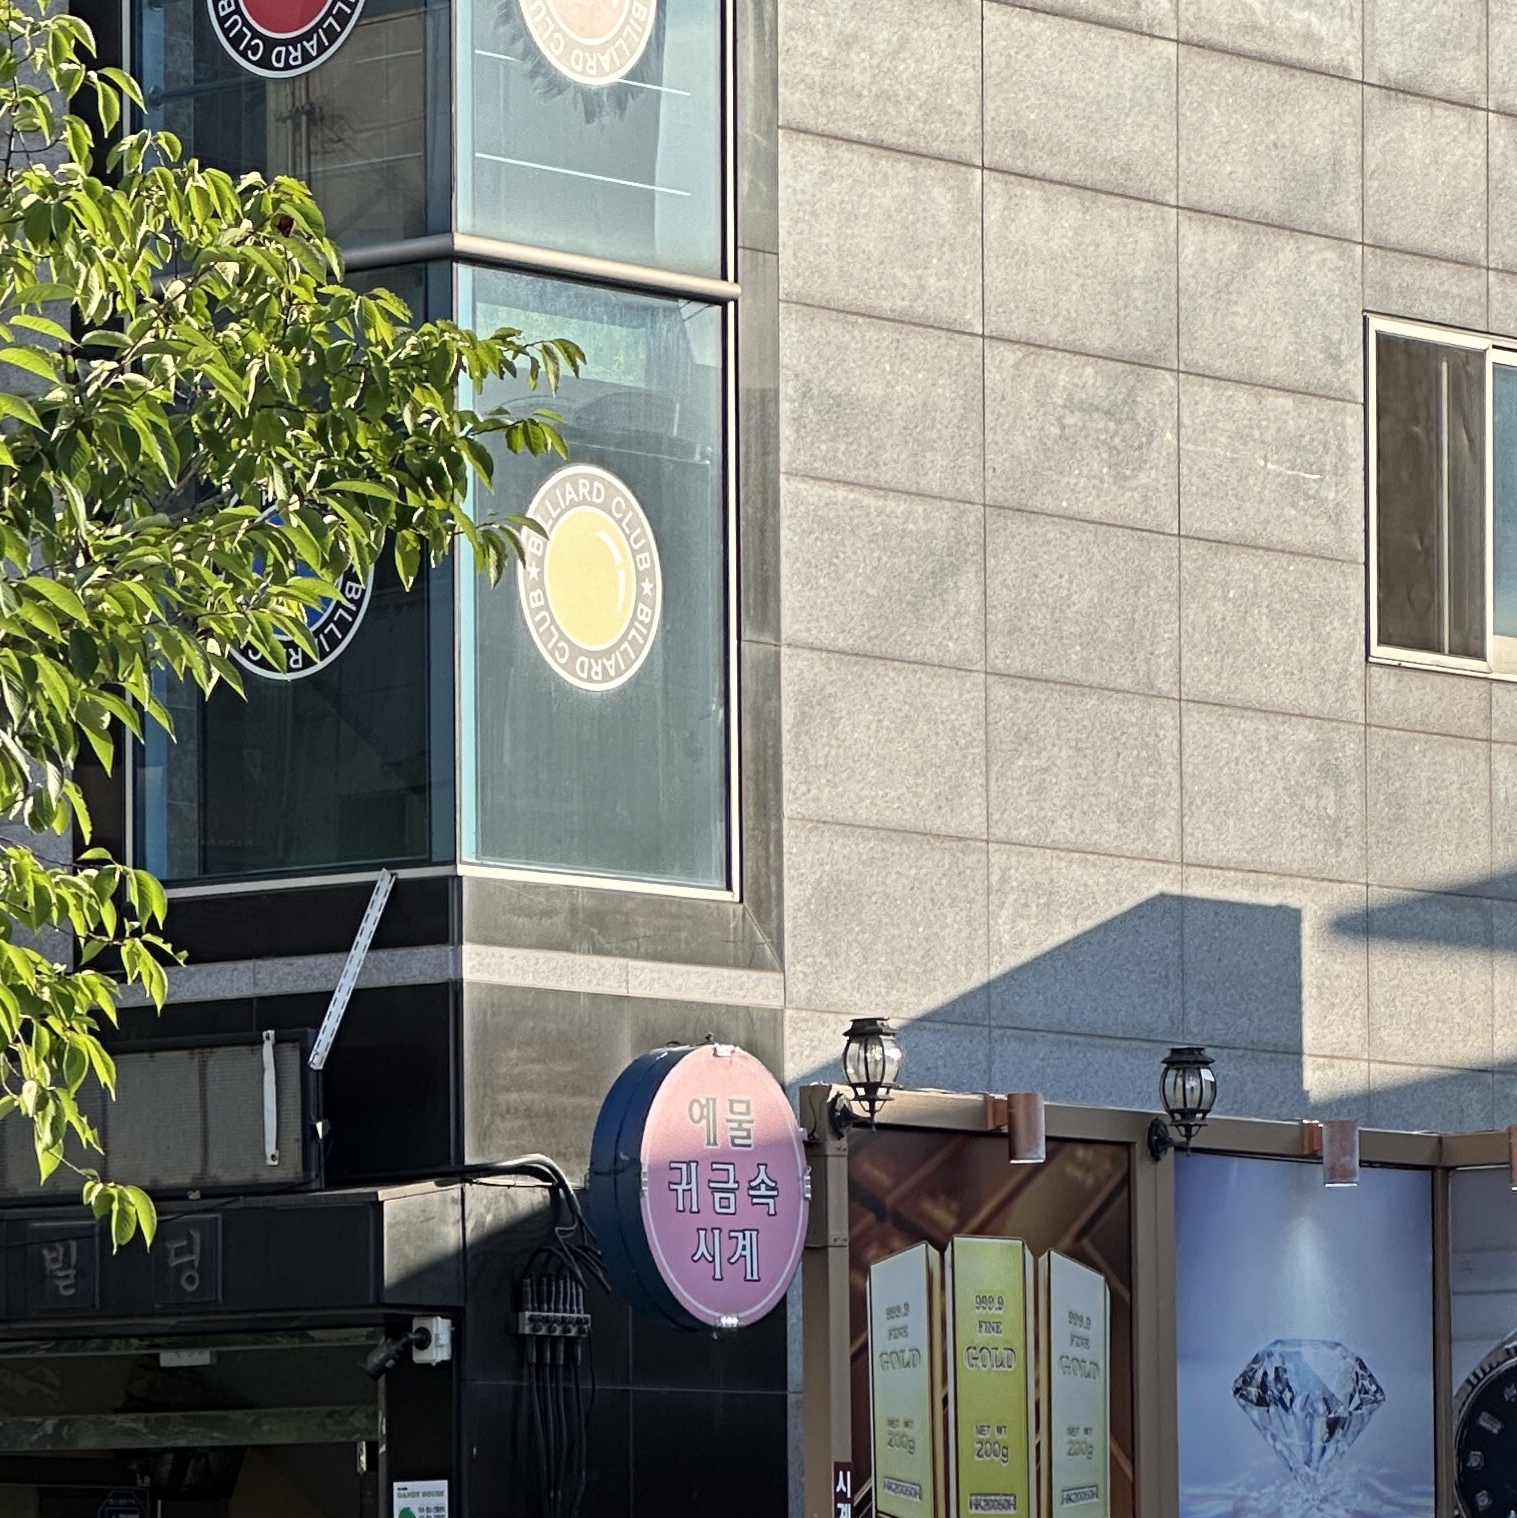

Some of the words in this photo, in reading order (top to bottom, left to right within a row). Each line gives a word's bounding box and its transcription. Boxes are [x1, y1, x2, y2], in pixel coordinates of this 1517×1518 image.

[272, 0, 356, 68] LLIARD
[529, 0, 565, 56] CLU
[571, 2, 648, 75] BILLIARD
[528, 479, 606, 557] BLLIARD
[611, 496, 651, 571] CLUB
[529, 588, 570, 665] CLUB
[576, 603, 652, 680] BILLIARD
[688, 1097, 755, 1150] 예물
[668, 1160, 779, 1216] 귀금속
[692, 1227, 761, 1282] 시계
[974, 1294, 1005, 1313] 999.9
[977, 1320, 1003, 1335] FINE
[879, 1348, 922, 1371] GOLD
[965, 1346, 1017, 1370] GOLD
[1059, 1354, 1100, 1380] GOLD
[887, 1435, 915, 1455] 200g
[975, 1424, 991, 1437] NET
[996, 1424, 1007, 1437] WT
[975, 1440, 1009, 1464] 200g
